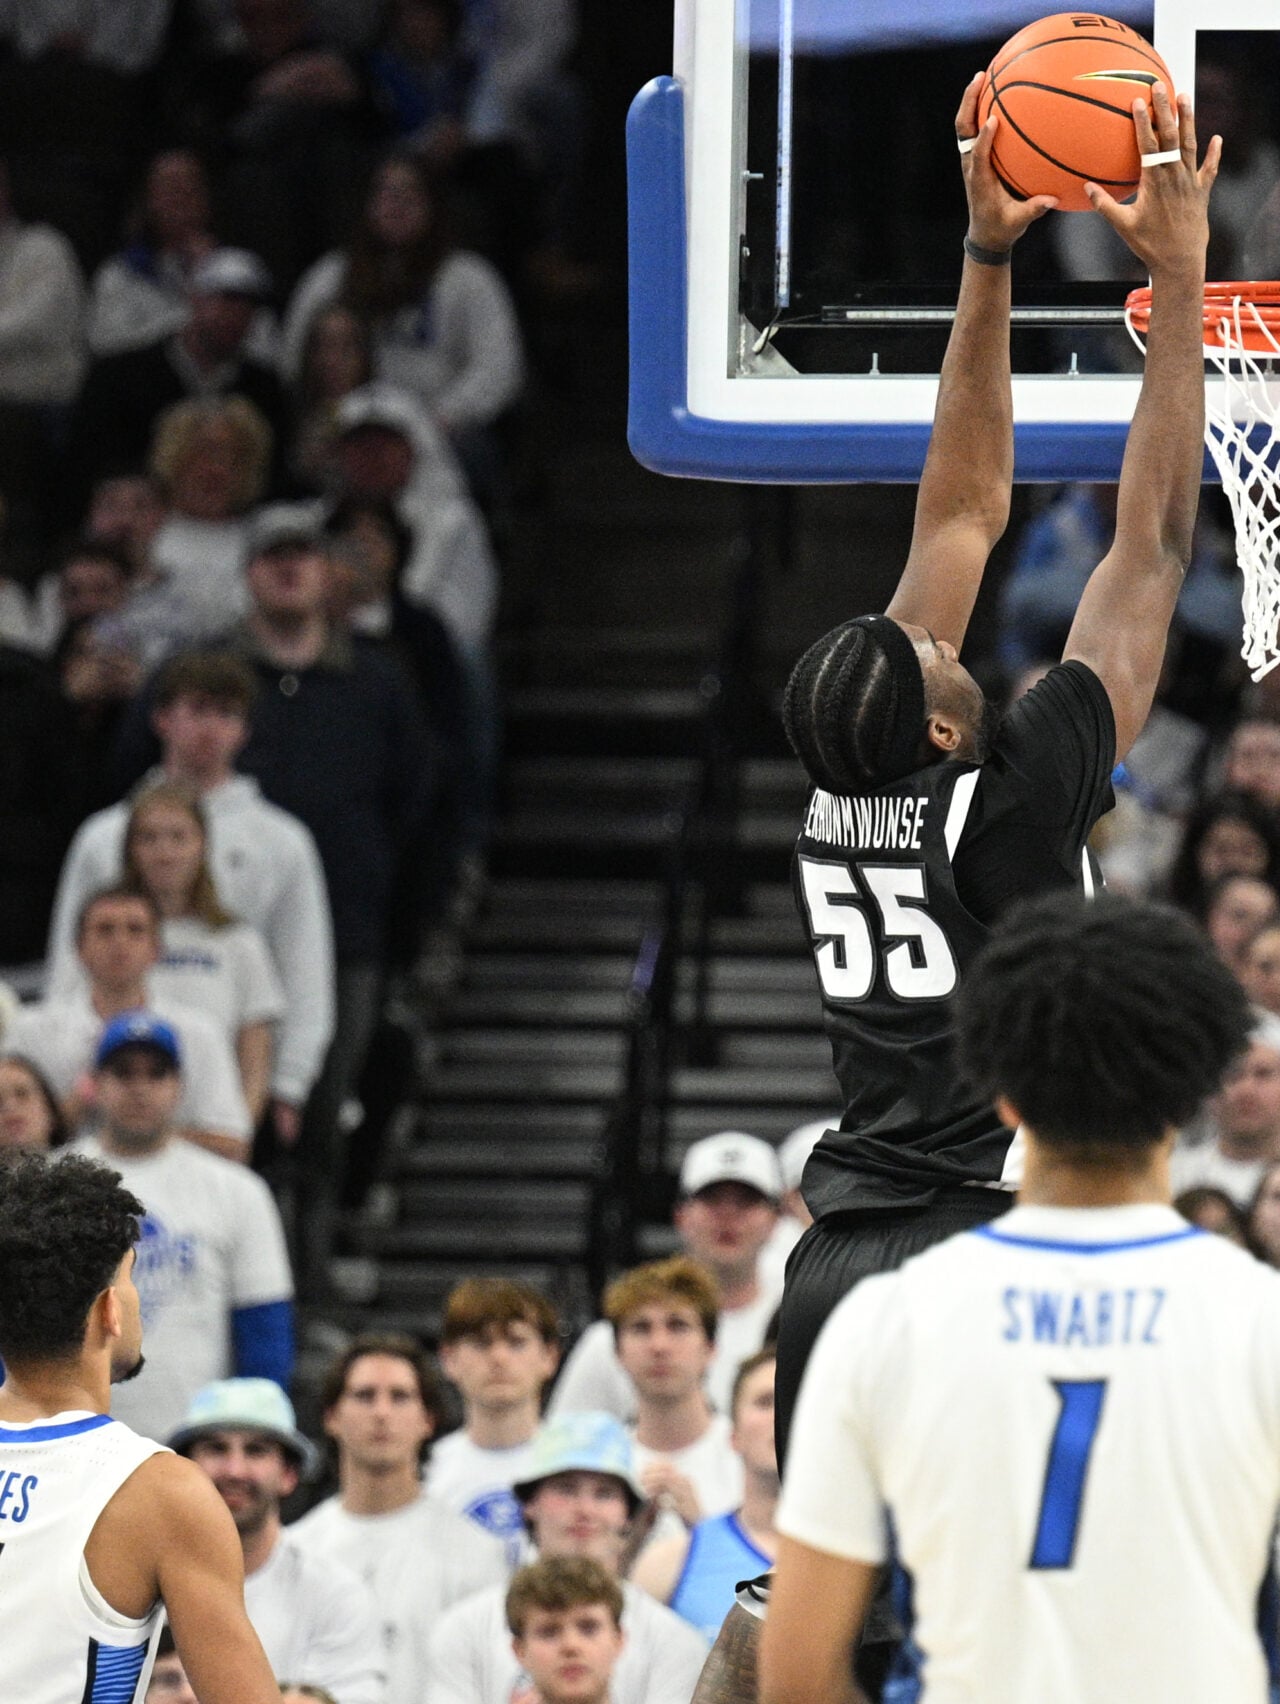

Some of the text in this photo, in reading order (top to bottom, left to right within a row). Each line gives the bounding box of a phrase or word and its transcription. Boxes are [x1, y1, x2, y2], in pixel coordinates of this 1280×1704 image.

[799, 856, 958, 1001] 55
[1002, 1286, 1166, 1346] SWARTZ
[0, 1470, 38, 1523] ES
[1027, 1375, 1109, 1571] 1
